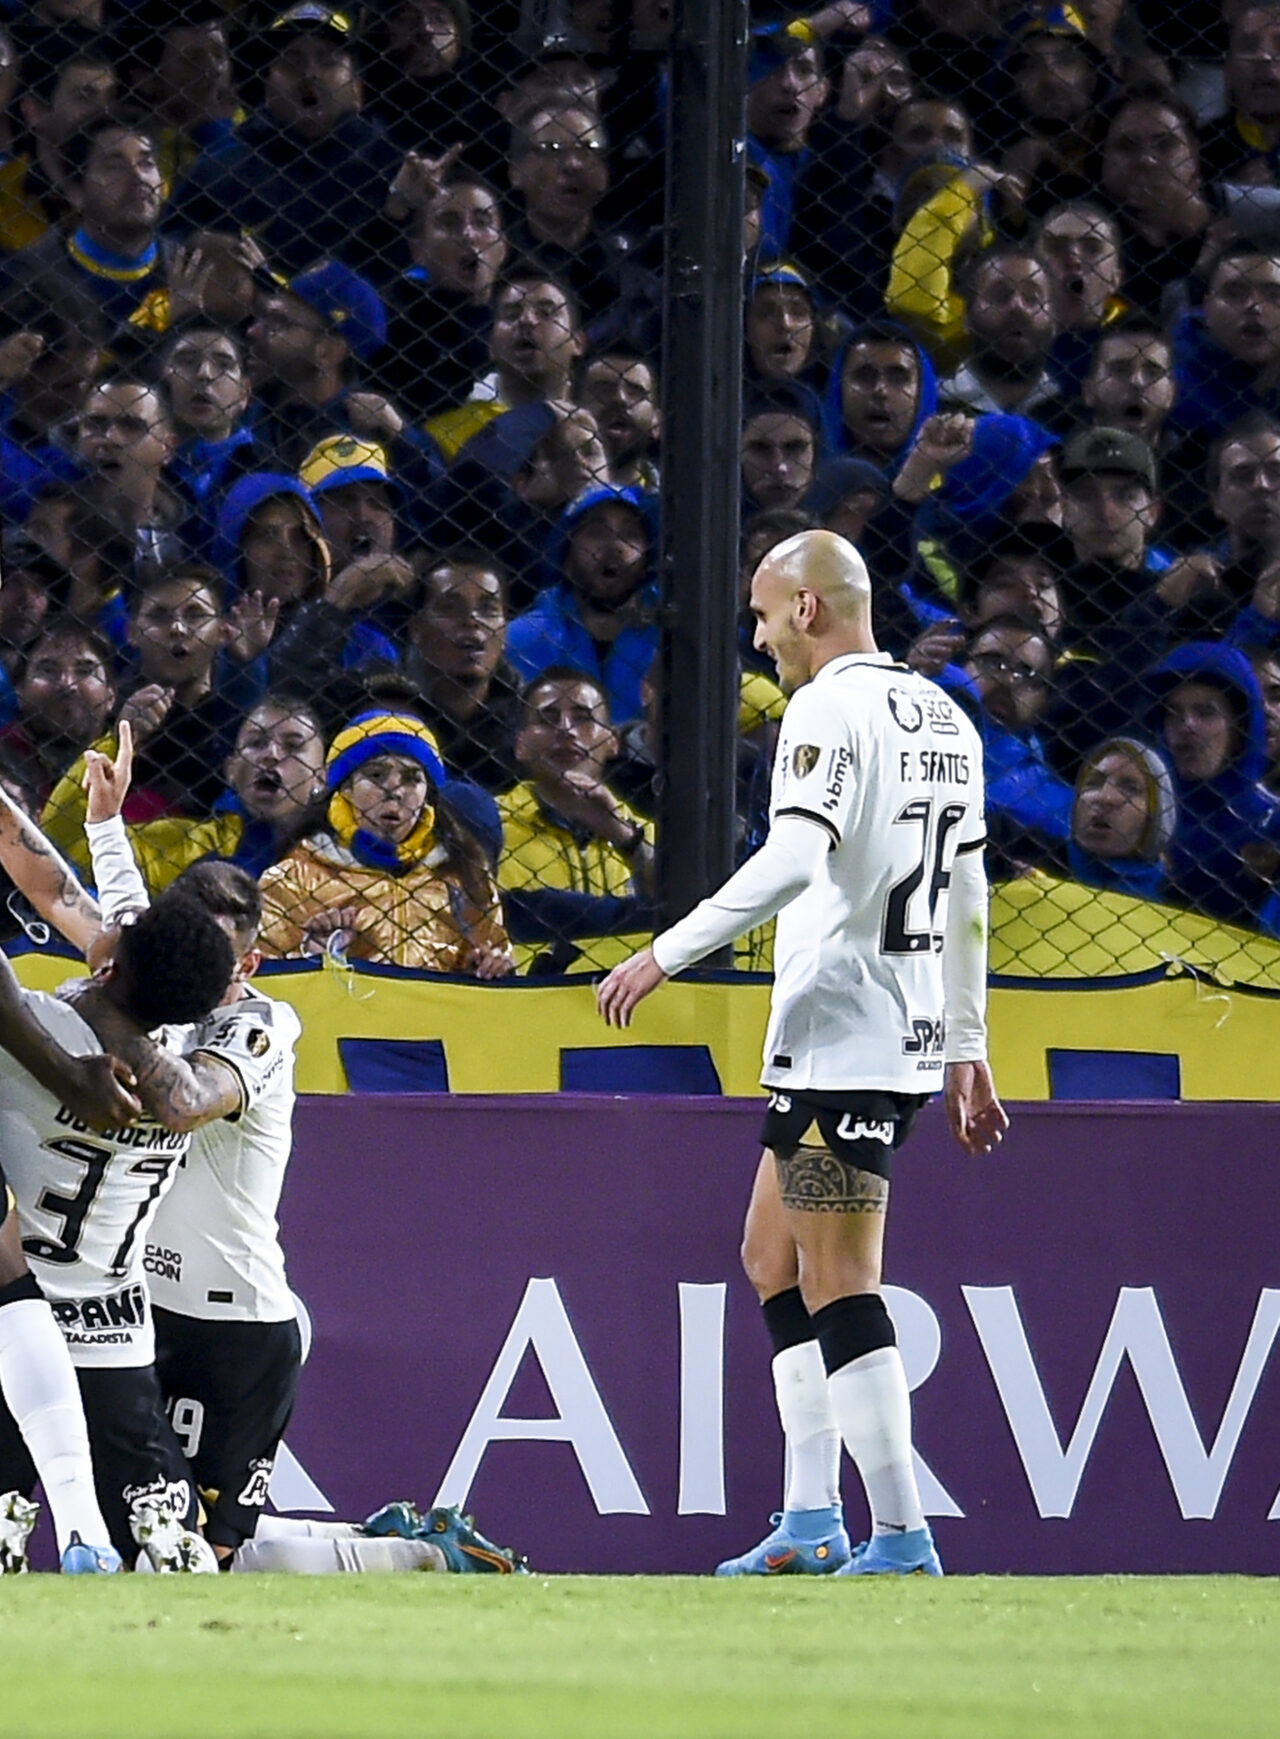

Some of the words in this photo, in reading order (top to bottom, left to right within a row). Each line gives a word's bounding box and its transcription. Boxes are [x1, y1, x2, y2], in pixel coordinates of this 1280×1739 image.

[826, 747, 854, 798] bmg
[20, 1136, 178, 1278] 37
[142, 1257, 181, 1282] COIN
[144, 1244, 182, 1265] CADO
[64, 1332, 133, 1344] TACADISTA
[434, 1277, 1280, 1521] AIRW
